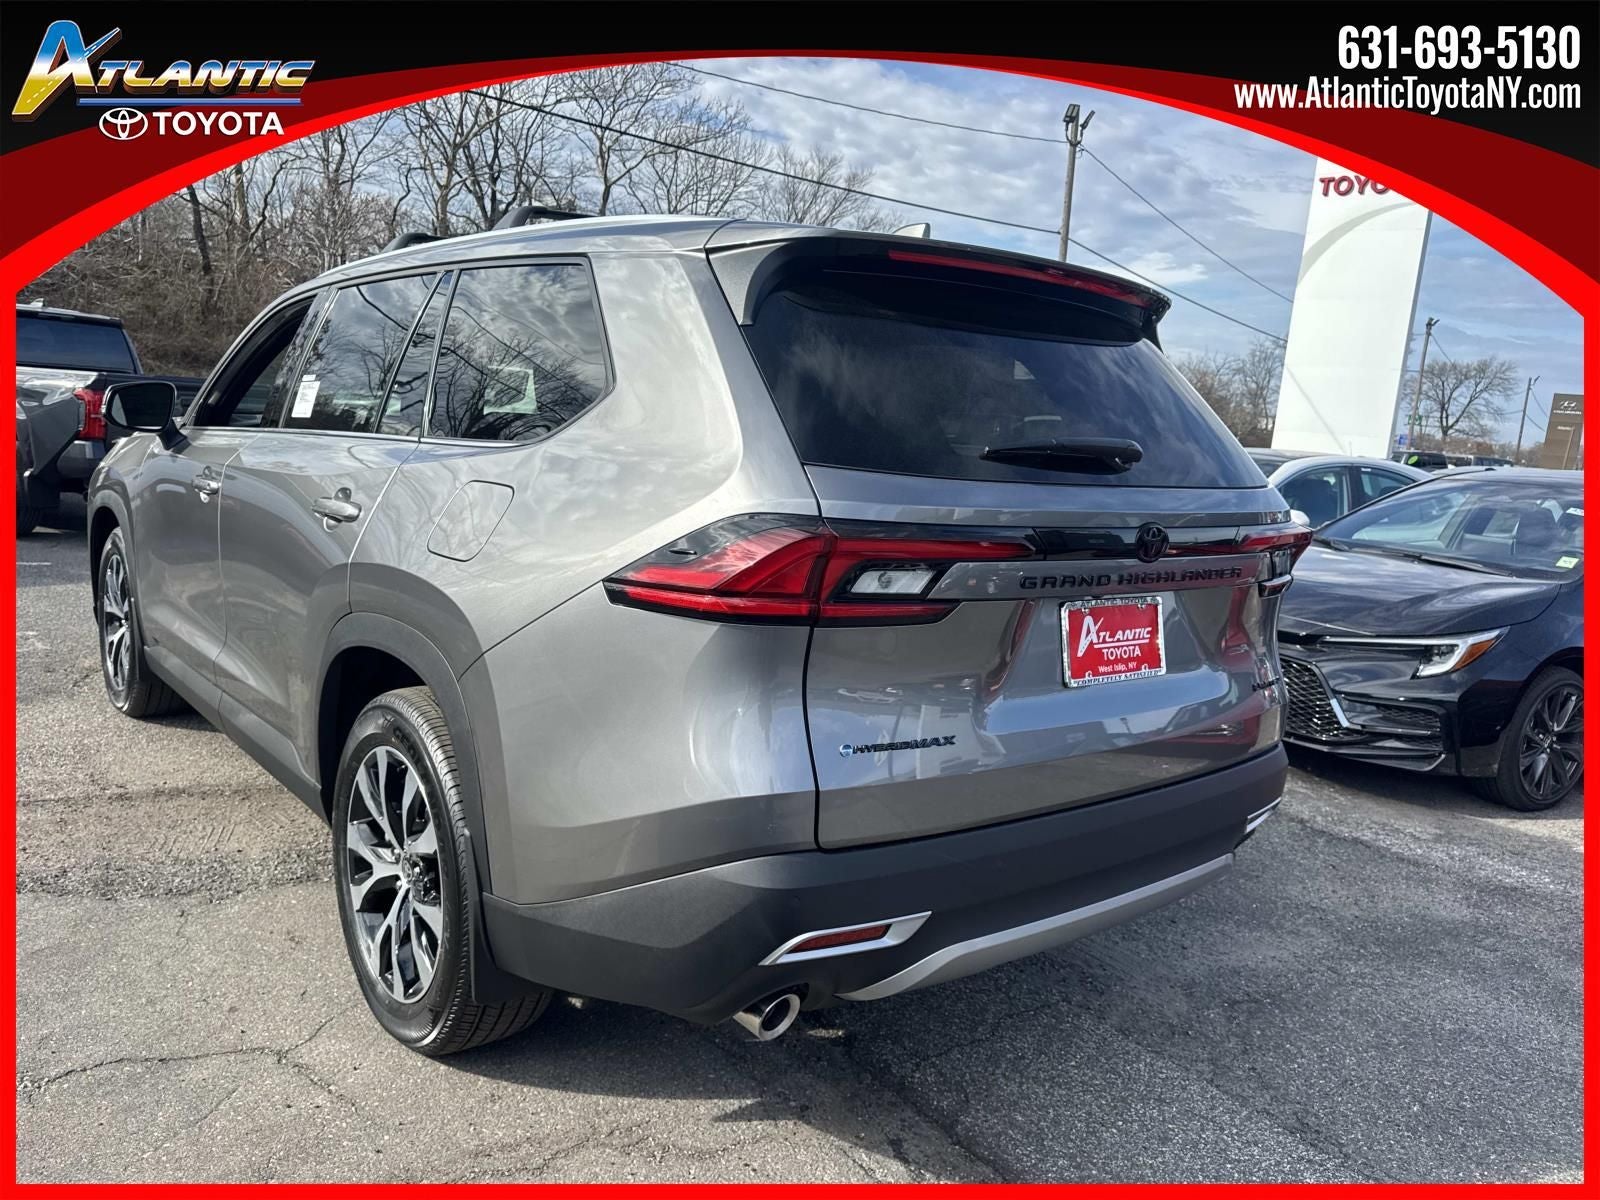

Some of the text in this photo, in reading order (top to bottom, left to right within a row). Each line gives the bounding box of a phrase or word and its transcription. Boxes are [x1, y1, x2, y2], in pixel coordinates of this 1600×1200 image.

[1019, 566, 1242, 590] GRAND HIGHLANDER
[1077, 615, 1152, 657] ATLANTIC
[1102, 646, 1141, 661] TOYOTA
[1097, 665, 1113, 673] West
